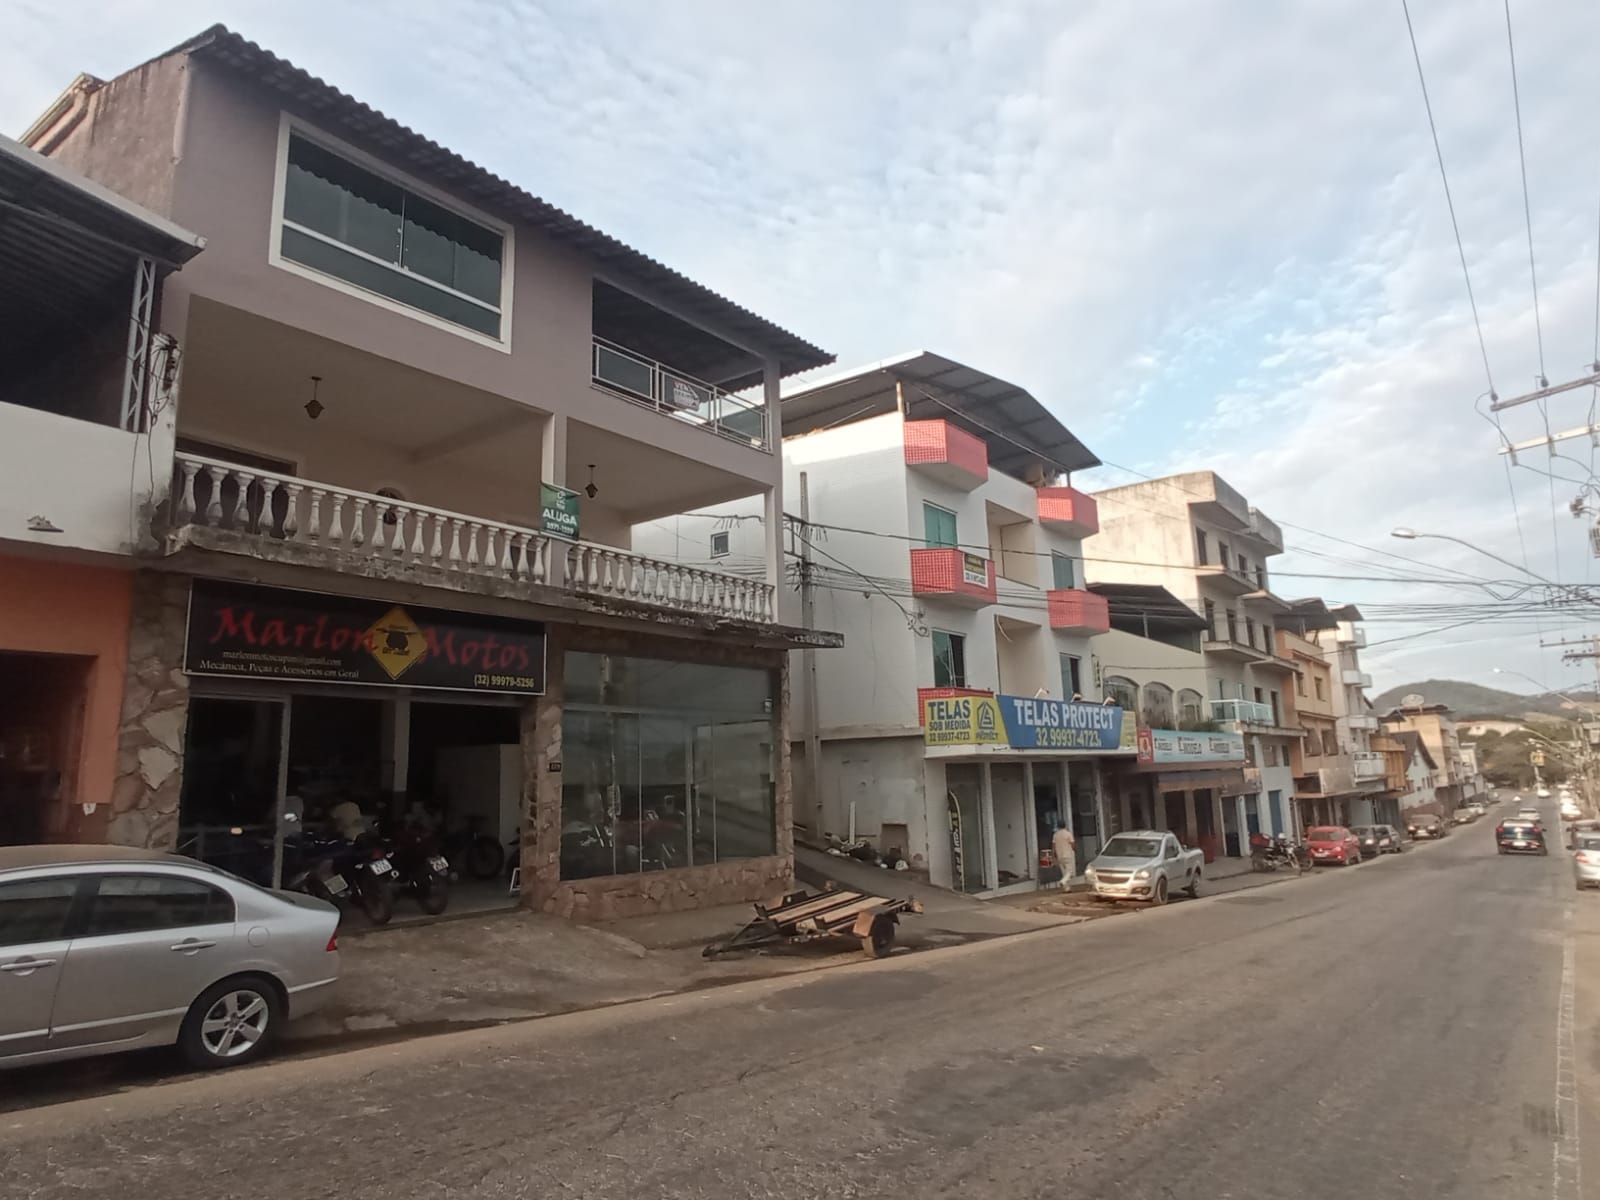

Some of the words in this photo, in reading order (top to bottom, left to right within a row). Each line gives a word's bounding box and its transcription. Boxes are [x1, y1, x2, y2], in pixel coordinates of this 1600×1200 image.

[542, 508, 577, 526] ALUGA
[209, 607, 378, 653] Marlon
[420, 626, 529, 671] Motos
[337, 669, 359, 679] Geral
[474, 674, 489, 686] (32)
[928, 699, 971, 720] TELAS
[1013, 699, 1059, 726] TELAS
[1062, 703, 1114, 730] PROTECT
[929, 720, 943, 731] SOB
[944, 719, 971, 731] MEDIDA
[929, 732, 936, 742] 32
[938, 731, 970, 742] 99937-4723
[1035, 727, 1048, 746] 32
[1050, 728, 1099, 747] 99937-4723
